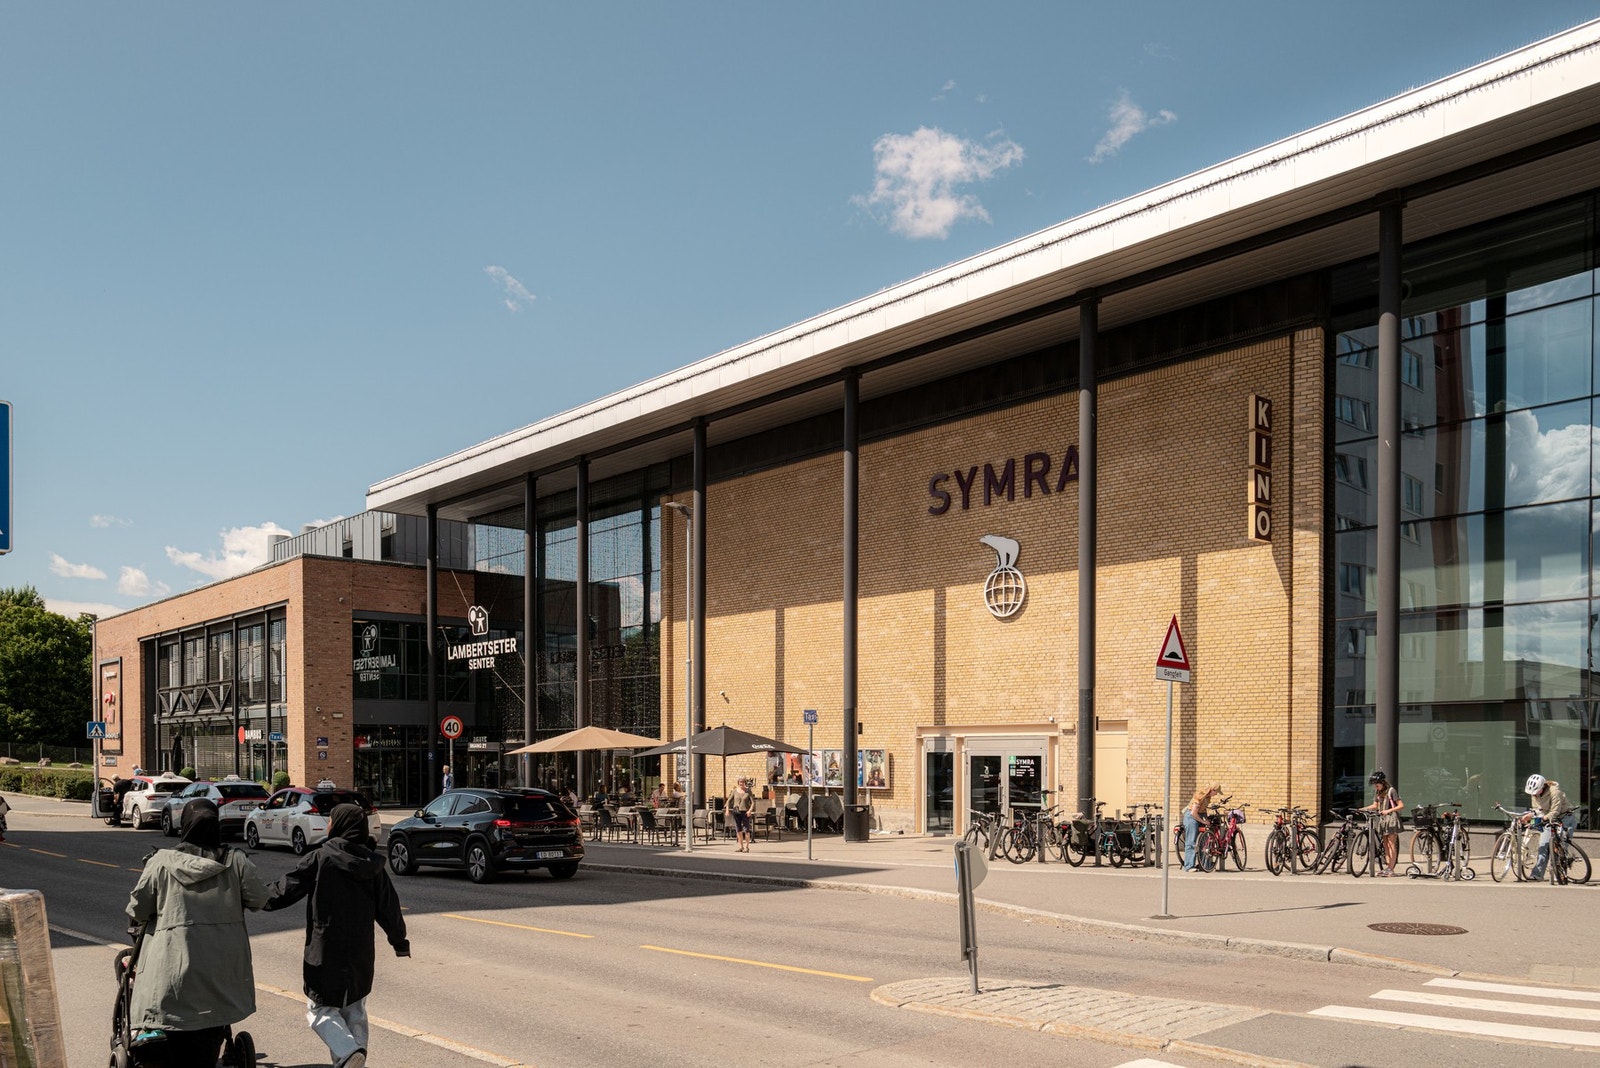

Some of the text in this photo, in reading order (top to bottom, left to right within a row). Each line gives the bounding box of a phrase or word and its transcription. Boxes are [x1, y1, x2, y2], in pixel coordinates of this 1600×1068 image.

[1257, 400, 1271, 537] KINO
[928, 445, 1079, 515] SYMRA
[447, 637, 517, 660] LAMBERTSETER
[468, 656, 495, 670] SENTER
[804, 712, 817, 721] Taxi
[445, 722, 459, 733] 40
